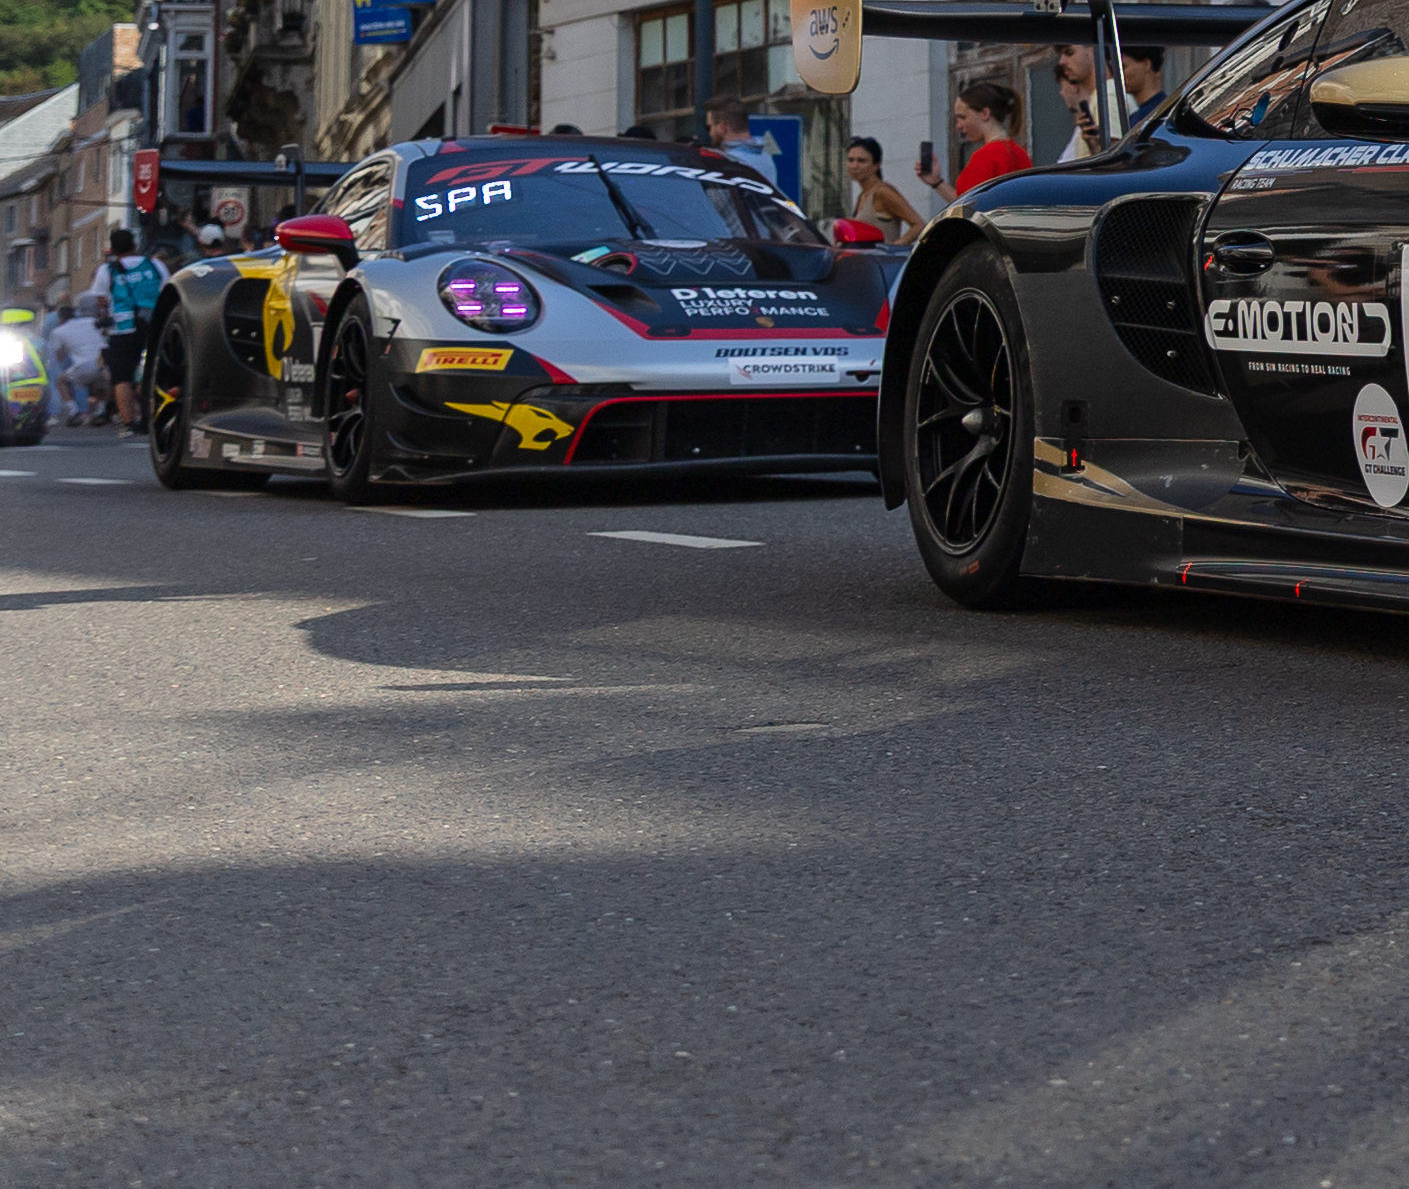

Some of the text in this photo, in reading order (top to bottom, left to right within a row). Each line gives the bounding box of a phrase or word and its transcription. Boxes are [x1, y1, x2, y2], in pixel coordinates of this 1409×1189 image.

[810, 6, 838, 36] aws
[1245, 144, 1380, 171] SCHUMACHER
[425, 157, 775, 195] GT WORLD
[415, 180, 512, 222] SPA
[679, 298, 754, 309] LUXURY
[683, 306, 831, 317] PERFORMANCE
[424, 351, 504, 366] PIRELLI
[714, 346, 849, 359] BOUTSEN VDS
[743, 362, 837, 375] CROWDSTRIKE
[1365, 463, 1406, 476] GT CHALLENGE
